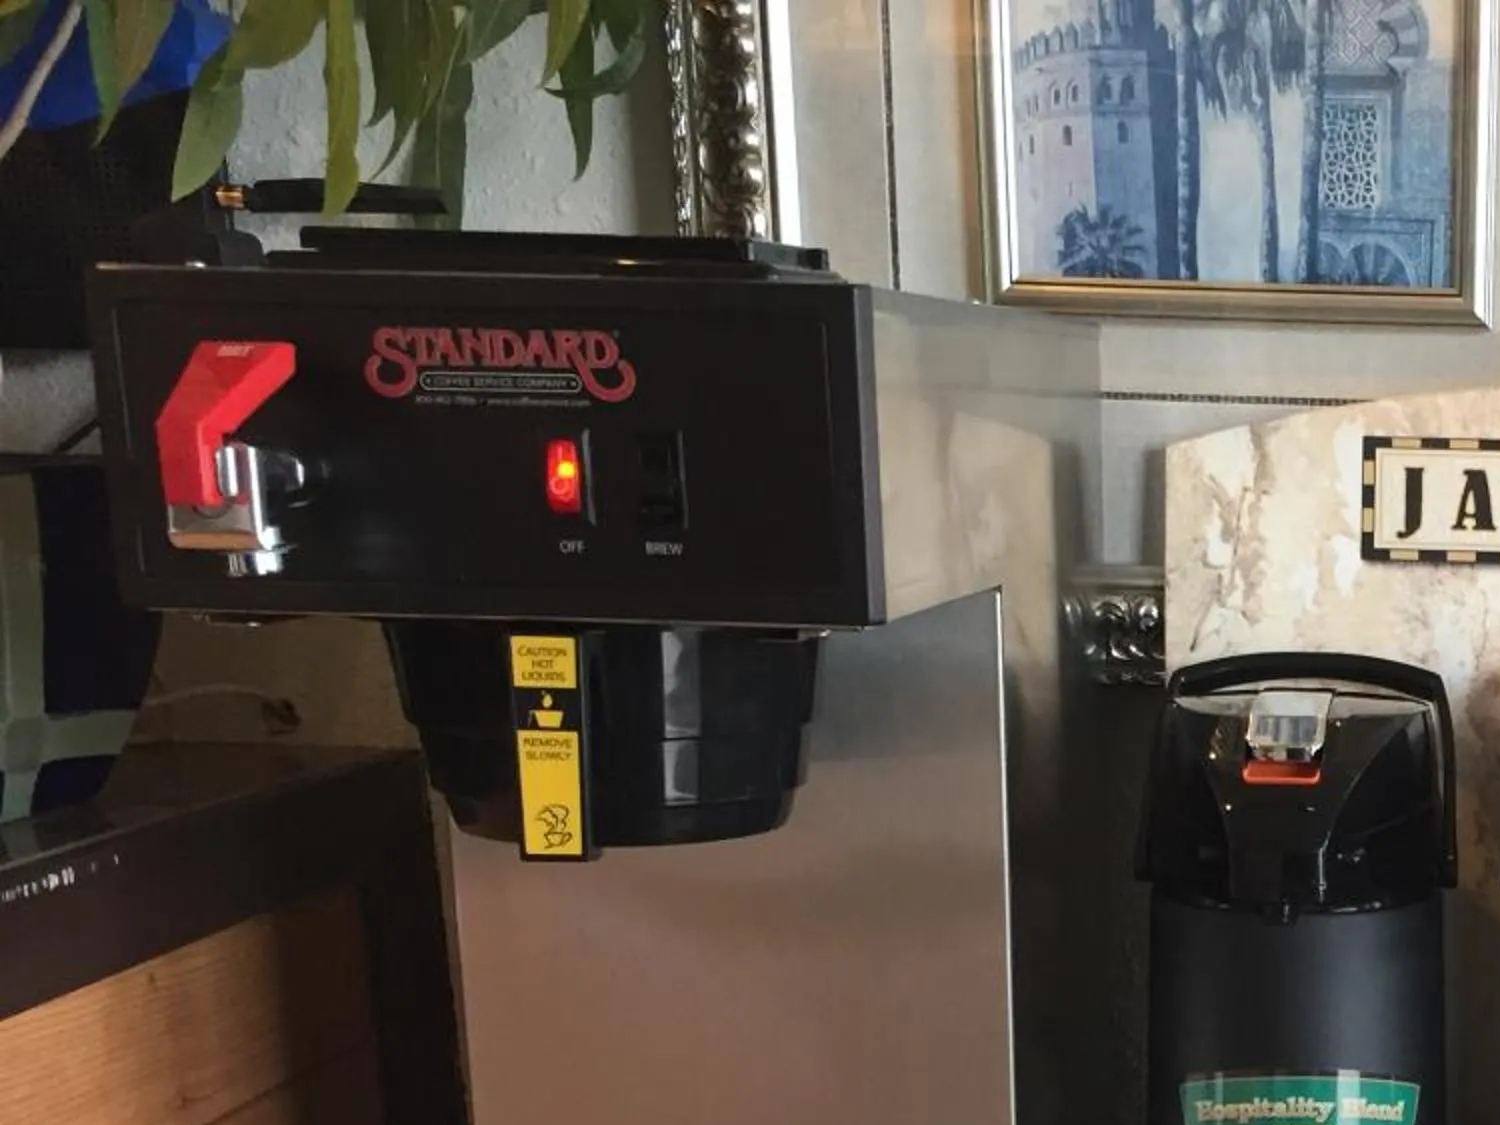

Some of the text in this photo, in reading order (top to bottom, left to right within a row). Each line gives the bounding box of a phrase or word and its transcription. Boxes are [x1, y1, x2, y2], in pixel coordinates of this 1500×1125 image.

[364, 327, 637, 402] STANDARD
[559, 540, 585, 553] OFF
[645, 541, 683, 555] BREW
[517, 645, 567, 657] CAUTION
[531, 659, 554, 670] HOT
[523, 737, 573, 749] REMOVE
